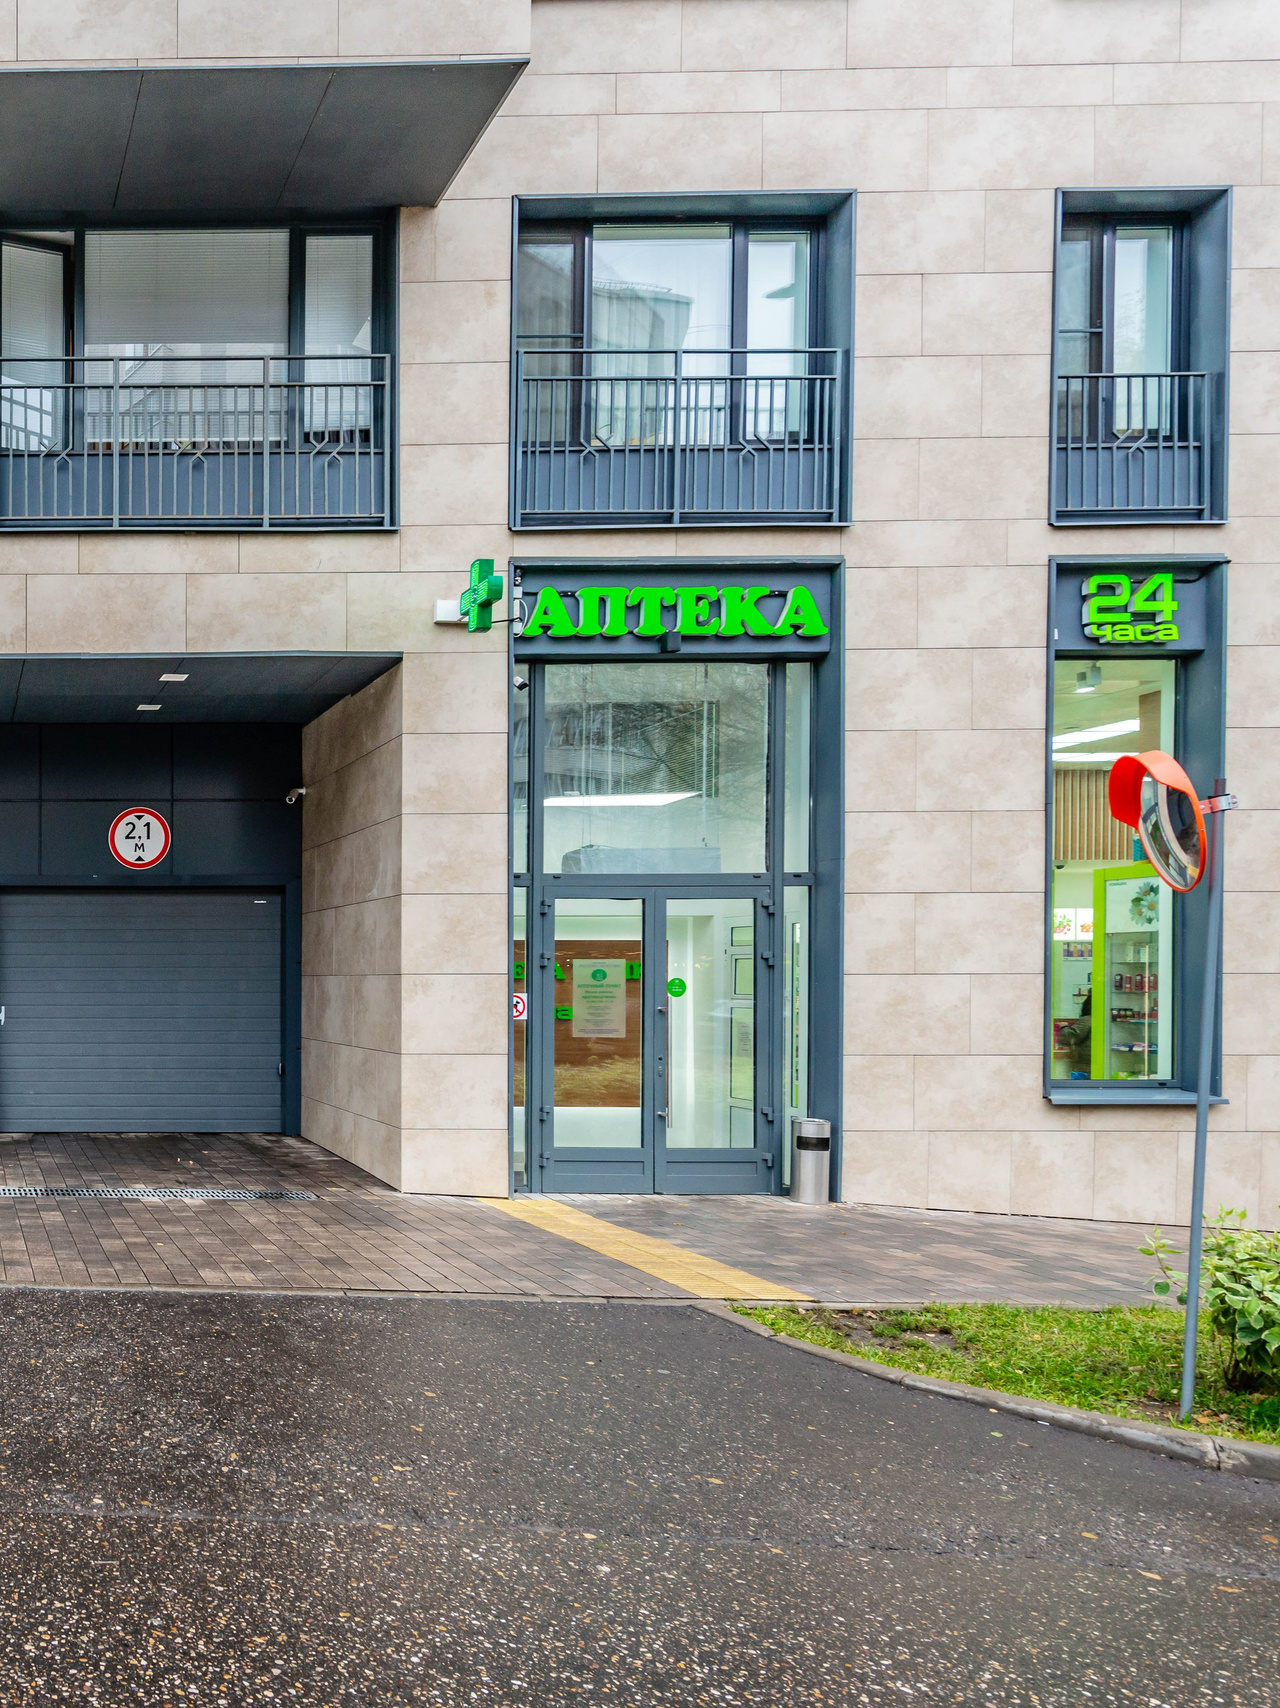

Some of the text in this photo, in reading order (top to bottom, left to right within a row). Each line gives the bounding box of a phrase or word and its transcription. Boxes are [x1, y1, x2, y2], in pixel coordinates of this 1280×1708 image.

[522, 585, 829, 637] АПТЕКА
[1084, 573, 1179, 622] 24
[1087, 624, 1179, 642] часа
[125, 822, 151, 842] 2,1
